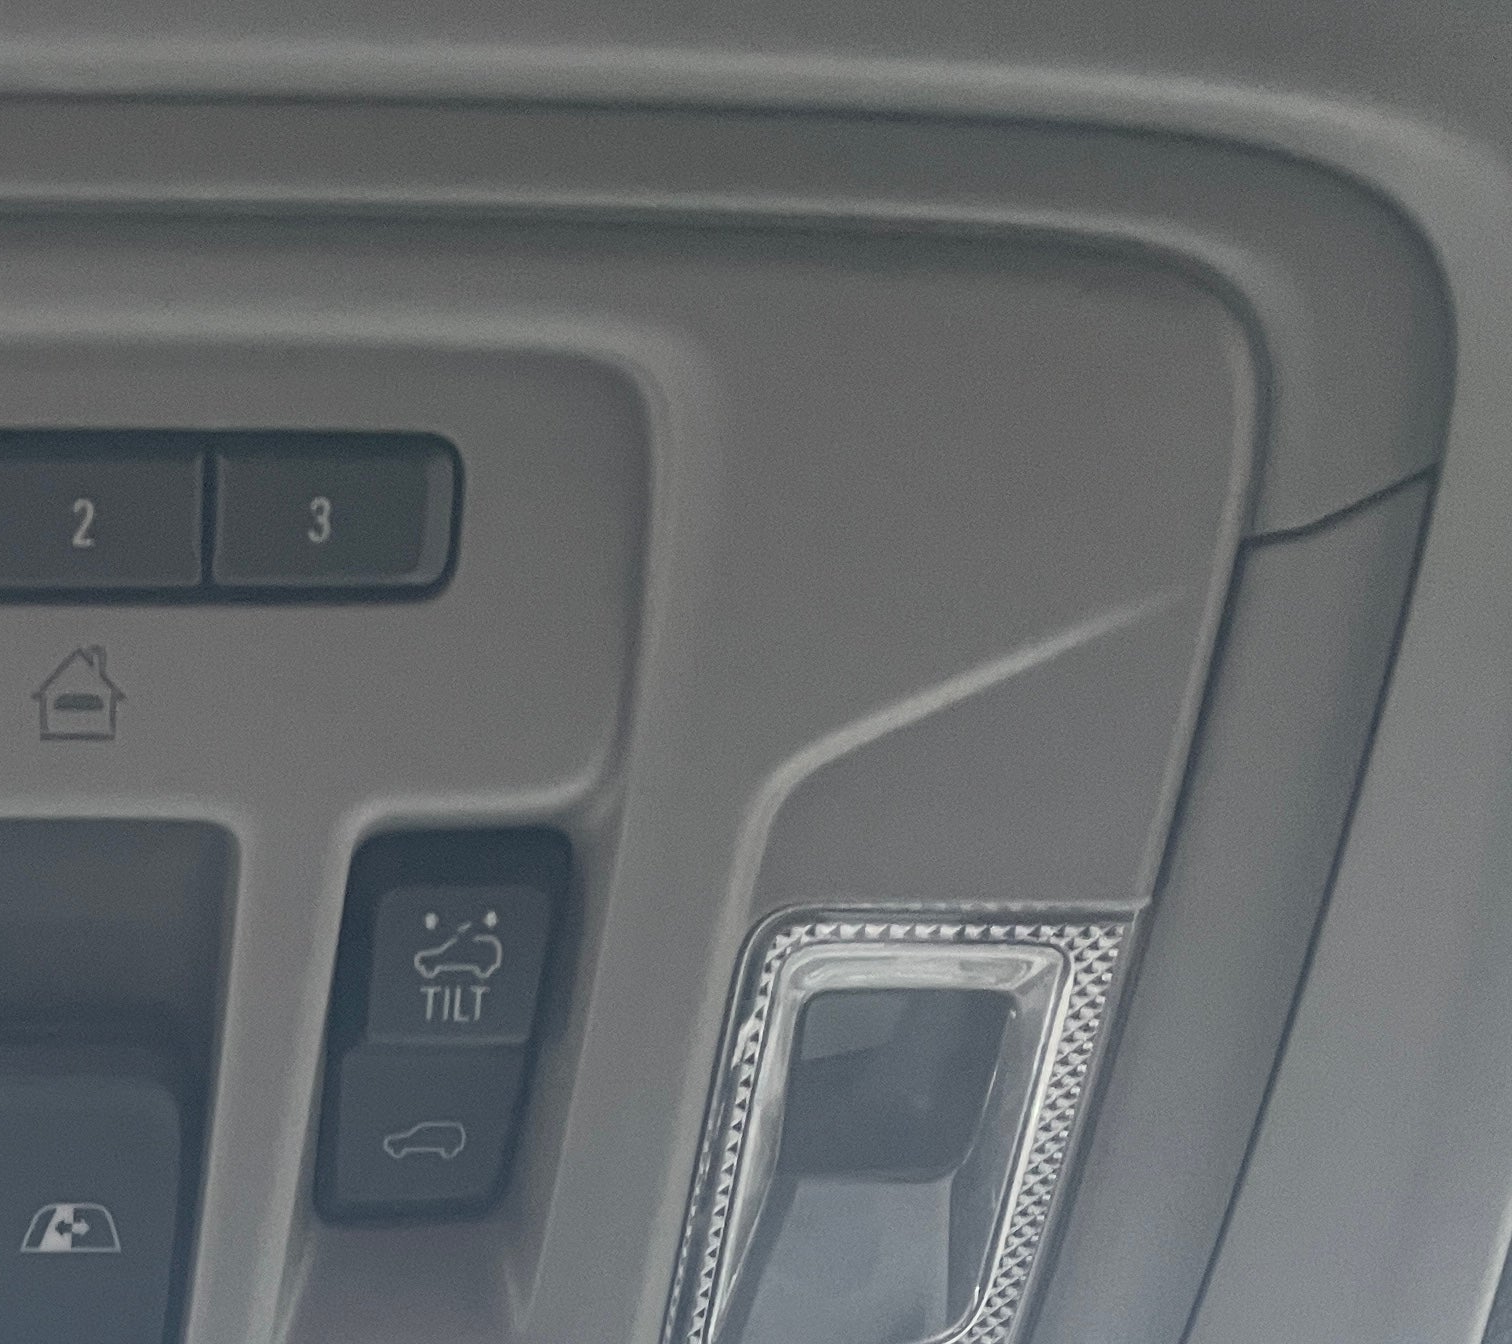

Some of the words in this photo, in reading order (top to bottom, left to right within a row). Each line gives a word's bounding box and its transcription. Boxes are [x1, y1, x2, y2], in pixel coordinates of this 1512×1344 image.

[71, 498, 96, 548] 2
[307, 495, 333, 543] 3
[419, 984, 491, 1022] TILT
